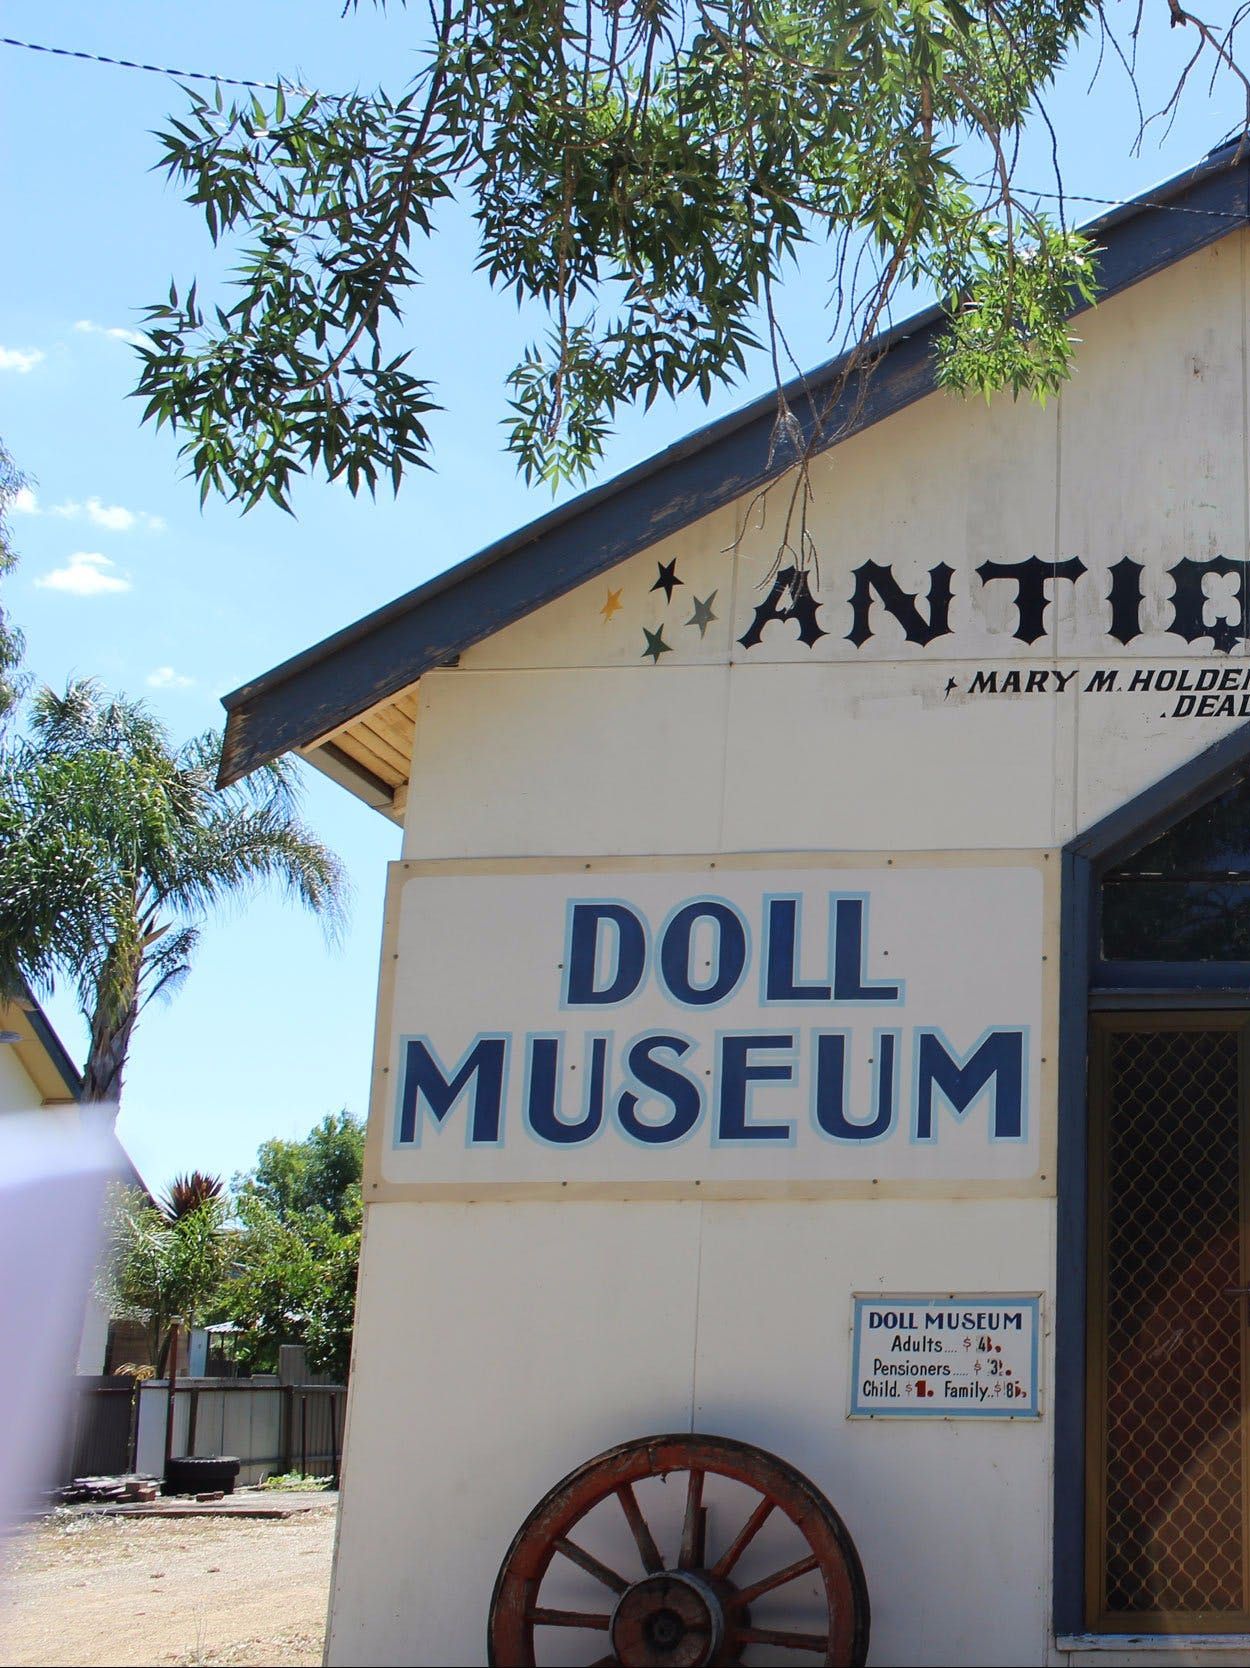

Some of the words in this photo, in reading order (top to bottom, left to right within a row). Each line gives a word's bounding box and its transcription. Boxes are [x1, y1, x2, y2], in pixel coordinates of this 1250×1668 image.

[967, 669, 1080, 694] MARY
[559, 891, 905, 1012] DOLL
[392, 1025, 1031, 1151] MUSEUM
[868, 1311, 919, 1330] DOLL
[925, 1311, 1023, 1331] MUSEUM
